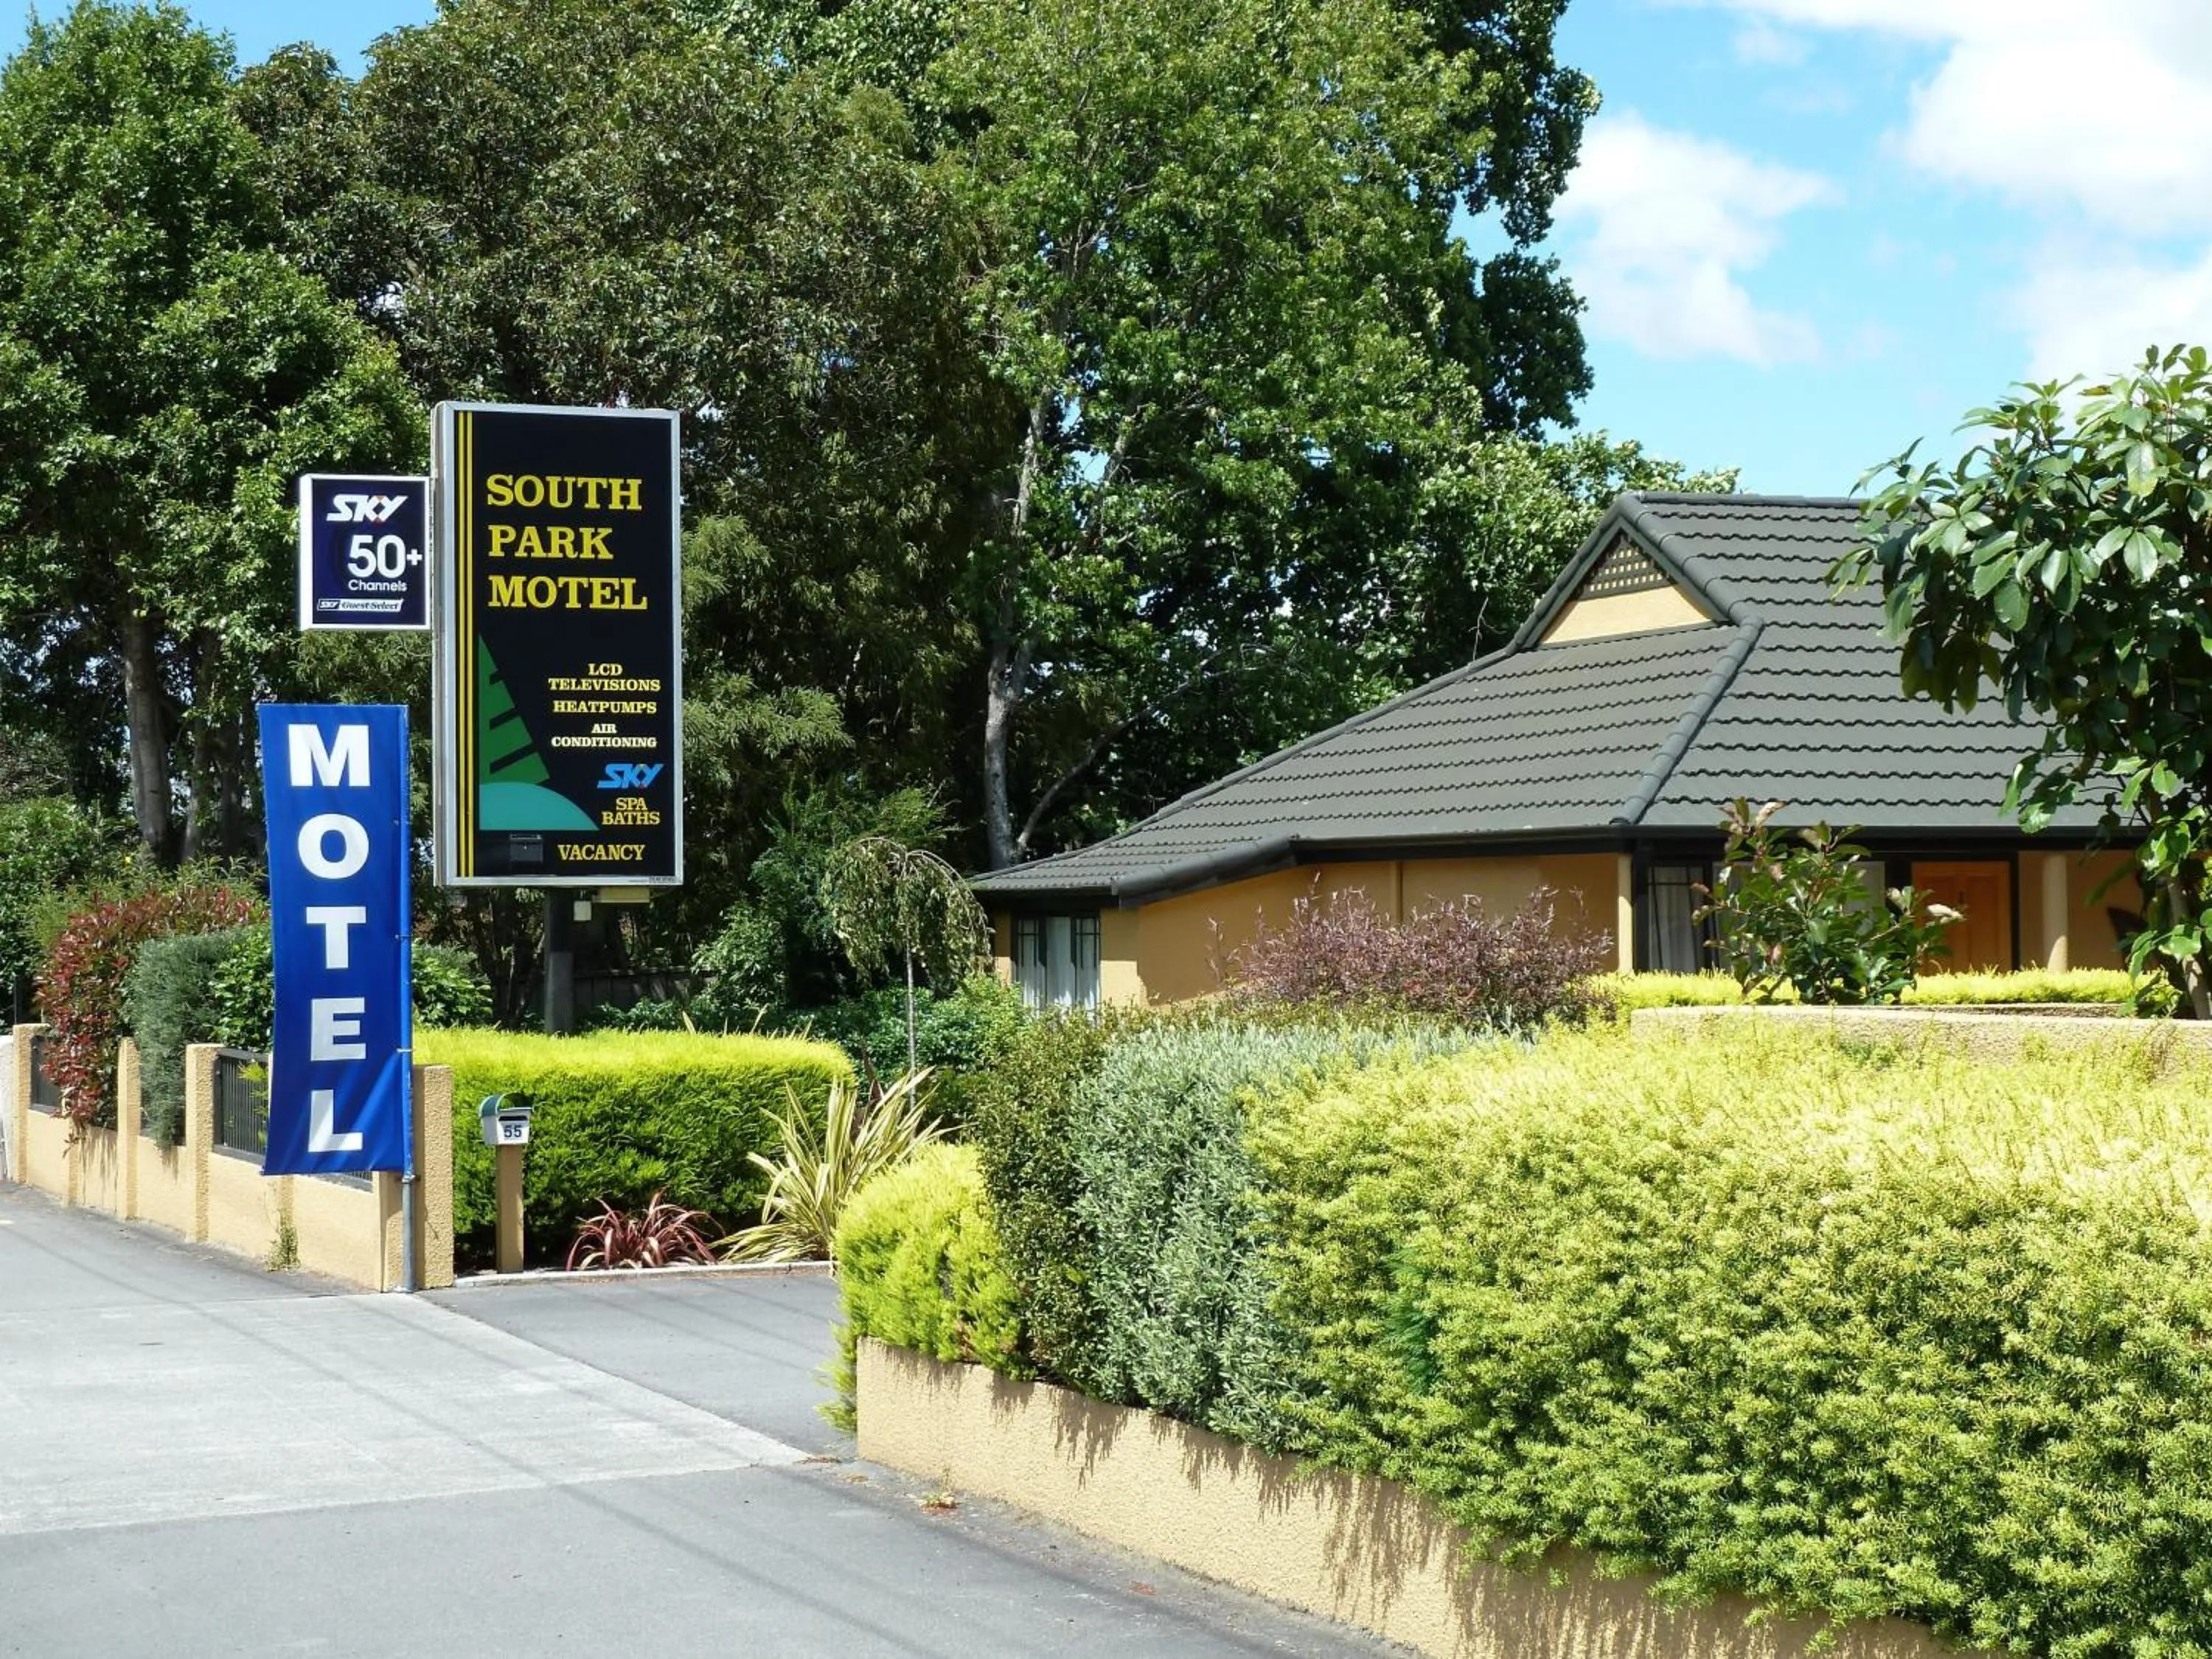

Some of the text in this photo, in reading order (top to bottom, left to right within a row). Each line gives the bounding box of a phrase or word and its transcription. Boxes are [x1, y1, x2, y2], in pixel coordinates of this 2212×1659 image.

[487, 474, 642, 510] SOUTH
[326, 494, 408, 522] SKY
[487, 524, 613, 560] PARK
[347, 535, 422, 578] 50+
[348, 579, 408, 592] Channels
[487, 575, 647, 610] MOTEL
[588, 664, 622, 676] LCD
[549, 678, 661, 692] TELEVISIONS
[553, 700, 657, 714] HEATPUMPS
[591, 723, 617, 734] AIR
[551, 737, 657, 748] CONDITIONING
[597, 763, 664, 788] SKY
[616, 797, 647, 810] SPA
[602, 811, 660, 825] BATHS
[557, 844, 645, 860] VACANCY
[288, 723, 371, 1153] MOTEL
[504, 1124, 522, 1138] 55
